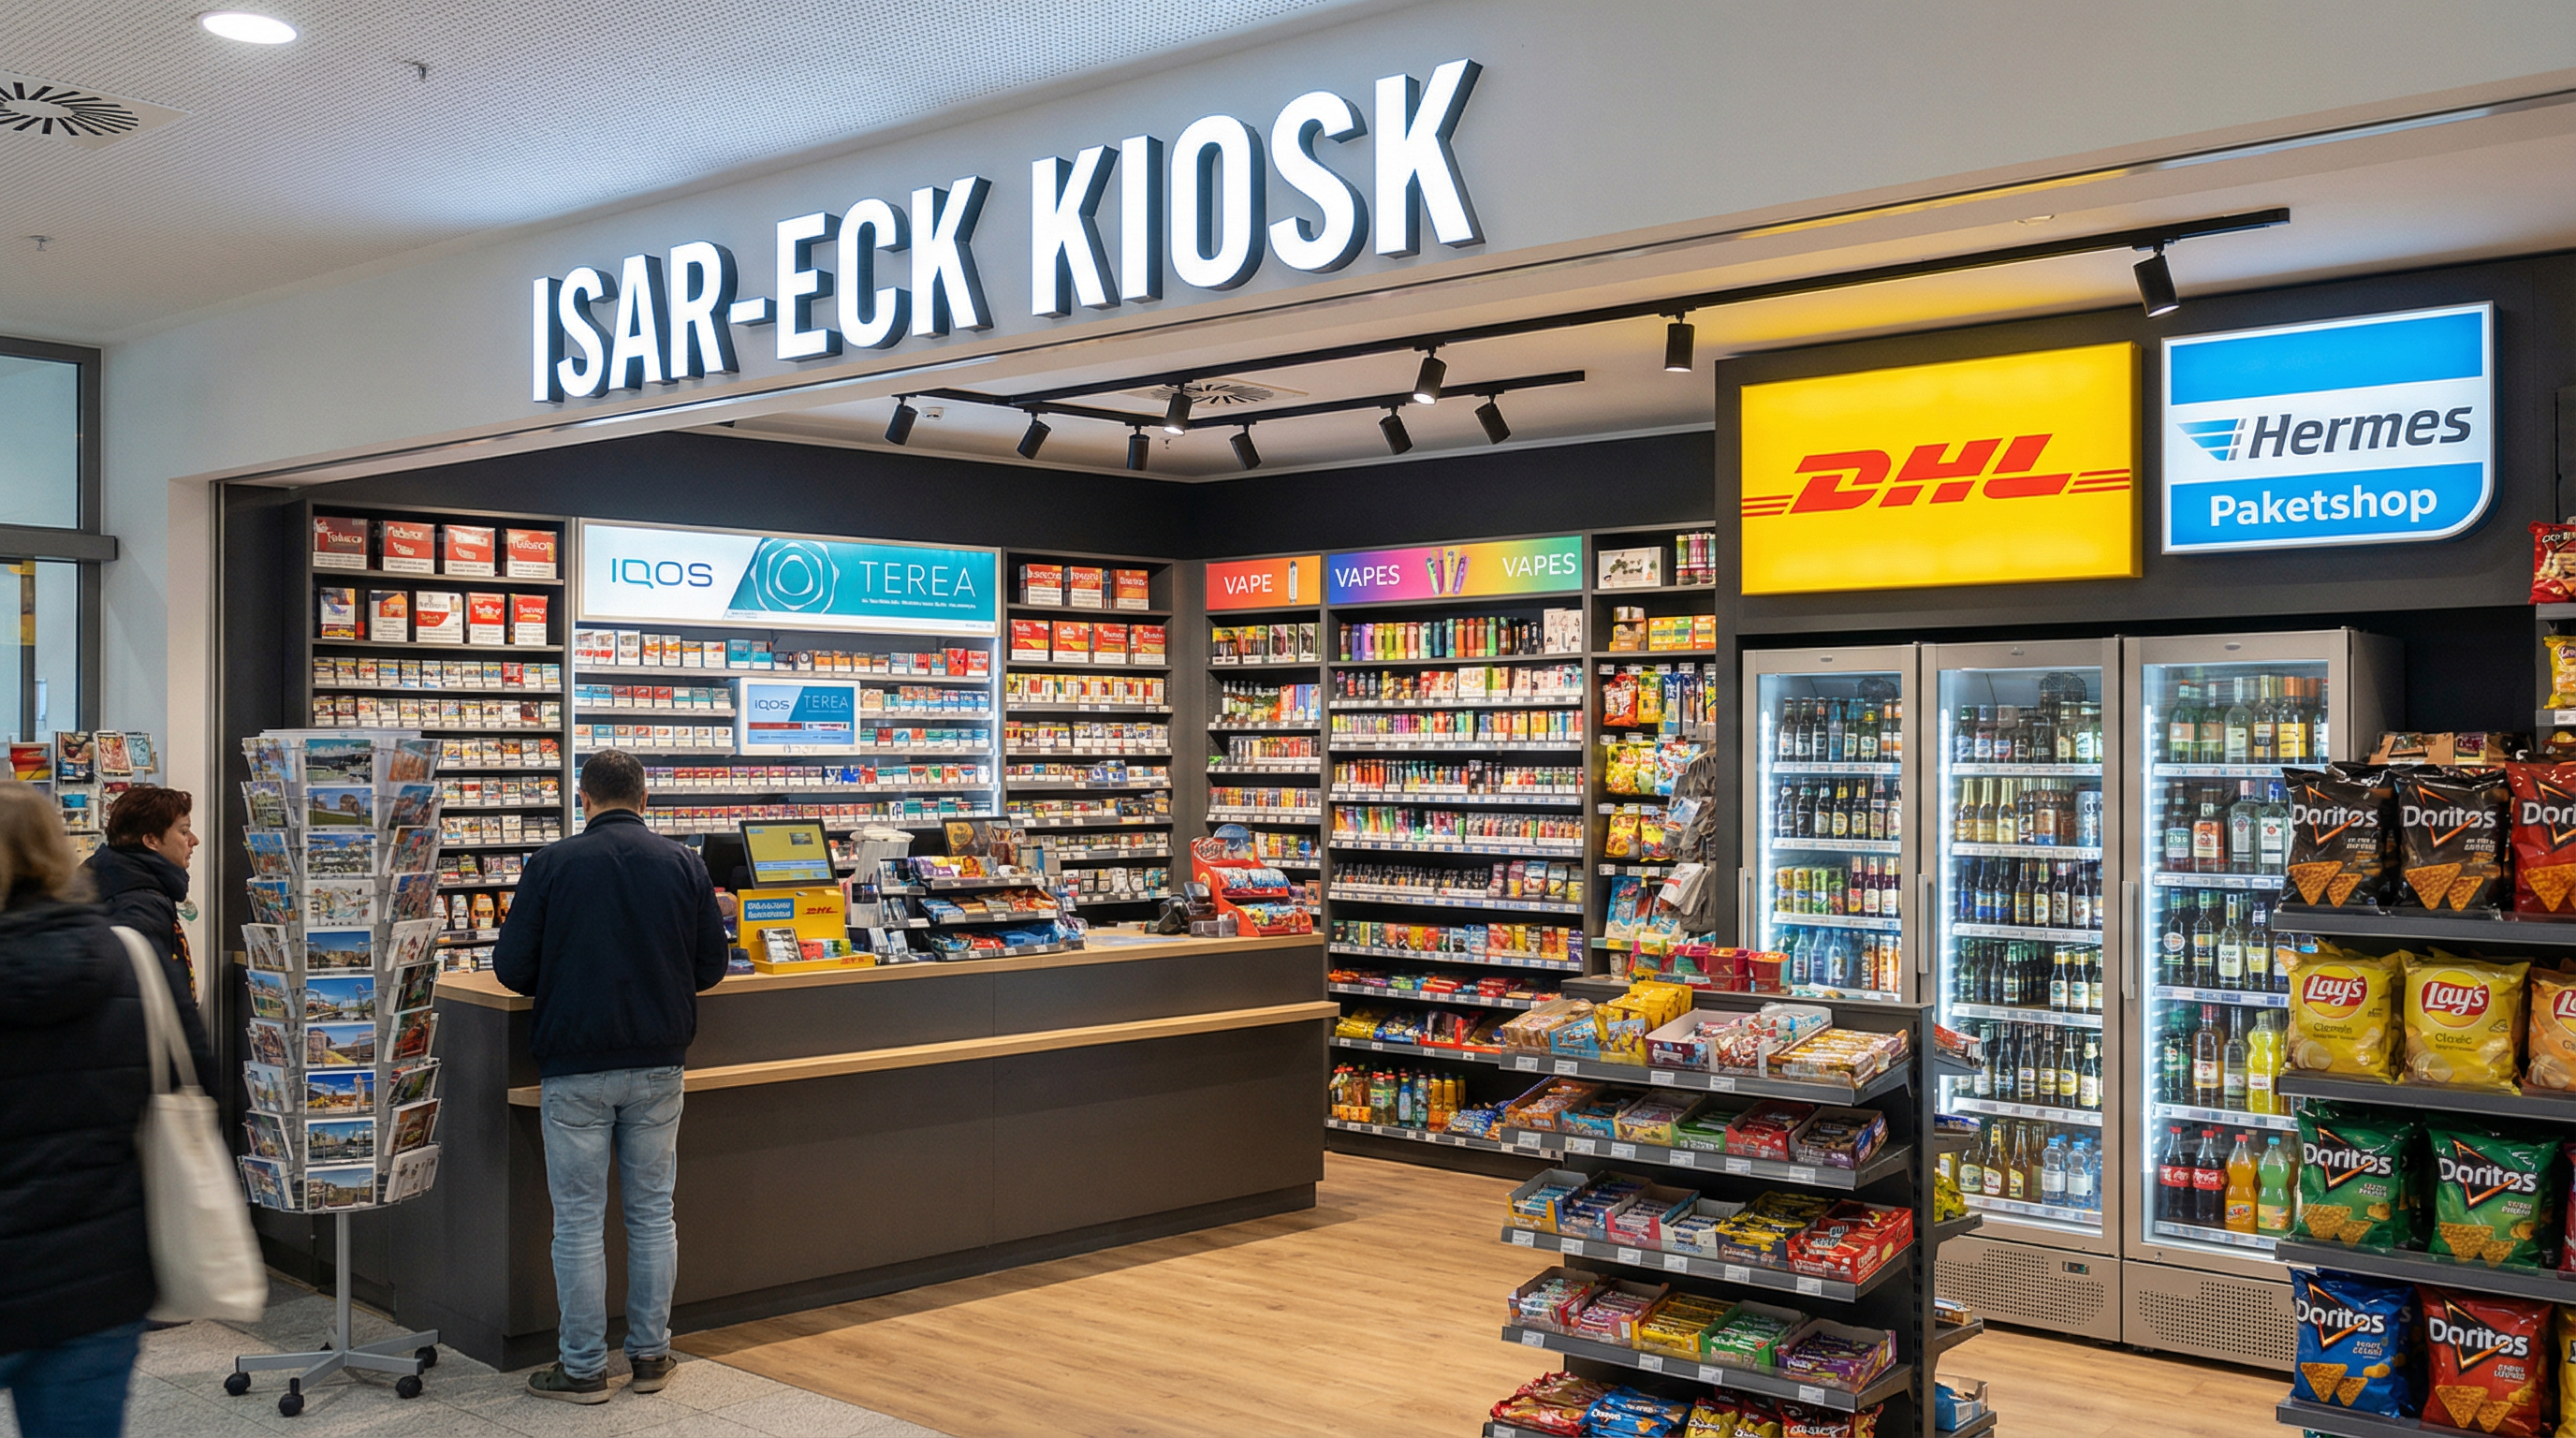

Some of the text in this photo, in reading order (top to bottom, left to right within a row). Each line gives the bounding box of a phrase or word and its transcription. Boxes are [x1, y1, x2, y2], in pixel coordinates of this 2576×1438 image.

[532, 57, 1485, 404] ISAR-ECK KIOSK
[2247, 405, 2473, 460] Hermes
[1789, 433, 2072, 514] DHL
[2210, 485, 2437, 527] Paketshop
[611, 557, 713, 590] IQOS
[858, 561, 976, 597] TEREA
[1335, 565, 1401, 588] VAPES
[1502, 552, 1576, 579] VAPES
[1223, 573, 1273, 595] VAPE
[754, 699, 790, 711] IQOS
[803, 695, 849, 709] TEREA
[2293, 804, 2378, 828] Doritos
[2403, 805, 2497, 829] Doritos
[2305, 976, 2364, 1006] Lay's
[2425, 983, 2487, 1017] Lay's
[2303, 1142, 2393, 1175] Doritos
[2439, 1158, 2538, 1192] Doritos
[2296, 1297, 2384, 1333] Doritos
[2429, 1317, 2528, 1357] Doritos
